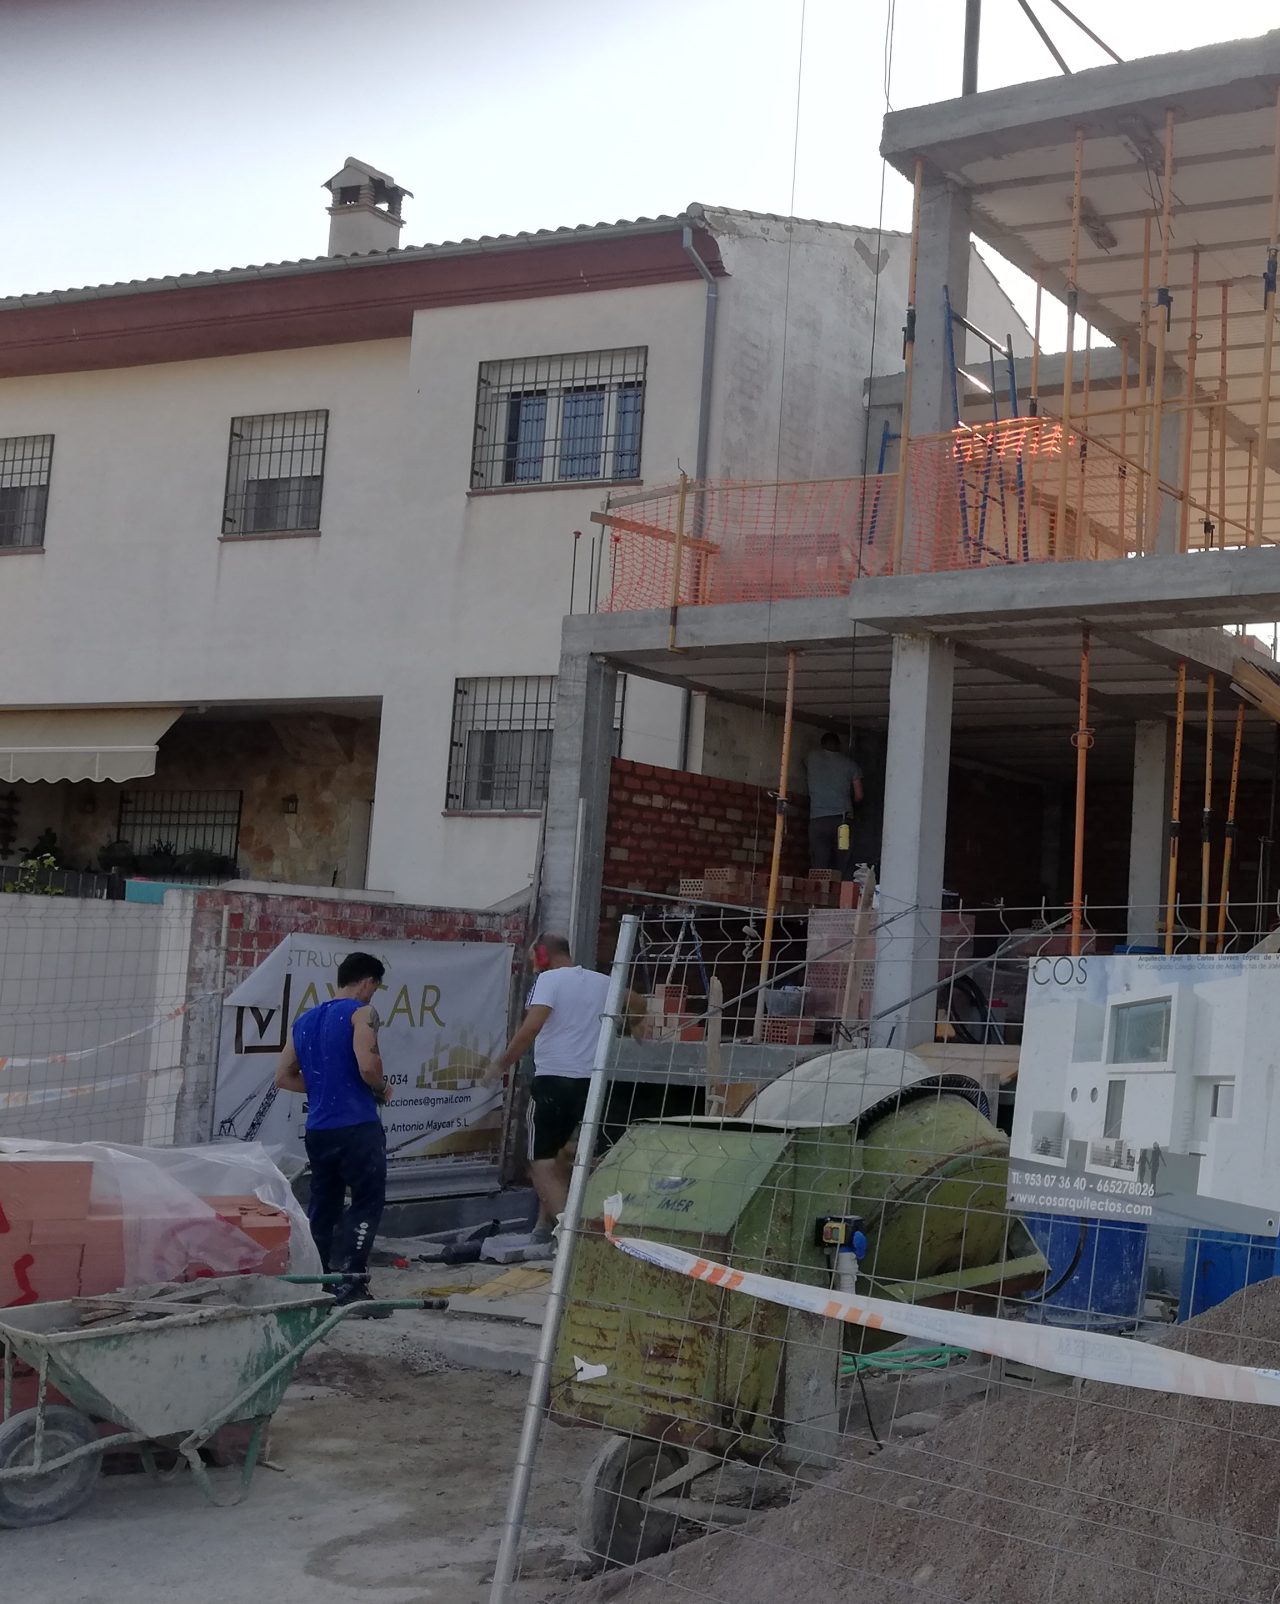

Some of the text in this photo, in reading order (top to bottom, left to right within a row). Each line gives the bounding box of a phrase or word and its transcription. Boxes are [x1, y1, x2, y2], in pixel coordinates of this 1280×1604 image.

[1033, 957, 1088, 985] COS
[390, 1121, 424, 1132] Antonio
[426, 1119, 455, 1131] Maycar
[1025, 1173, 1041, 1187] 953
[1044, 1175, 1056, 1188] 07
[1059, 1176, 1071, 1189] 36
[1073, 1177, 1087, 1191] 40
[1096, 1179, 1155, 1197] 665278026
[1010, 1192, 1153, 1216] www.cosarquitectos.com
